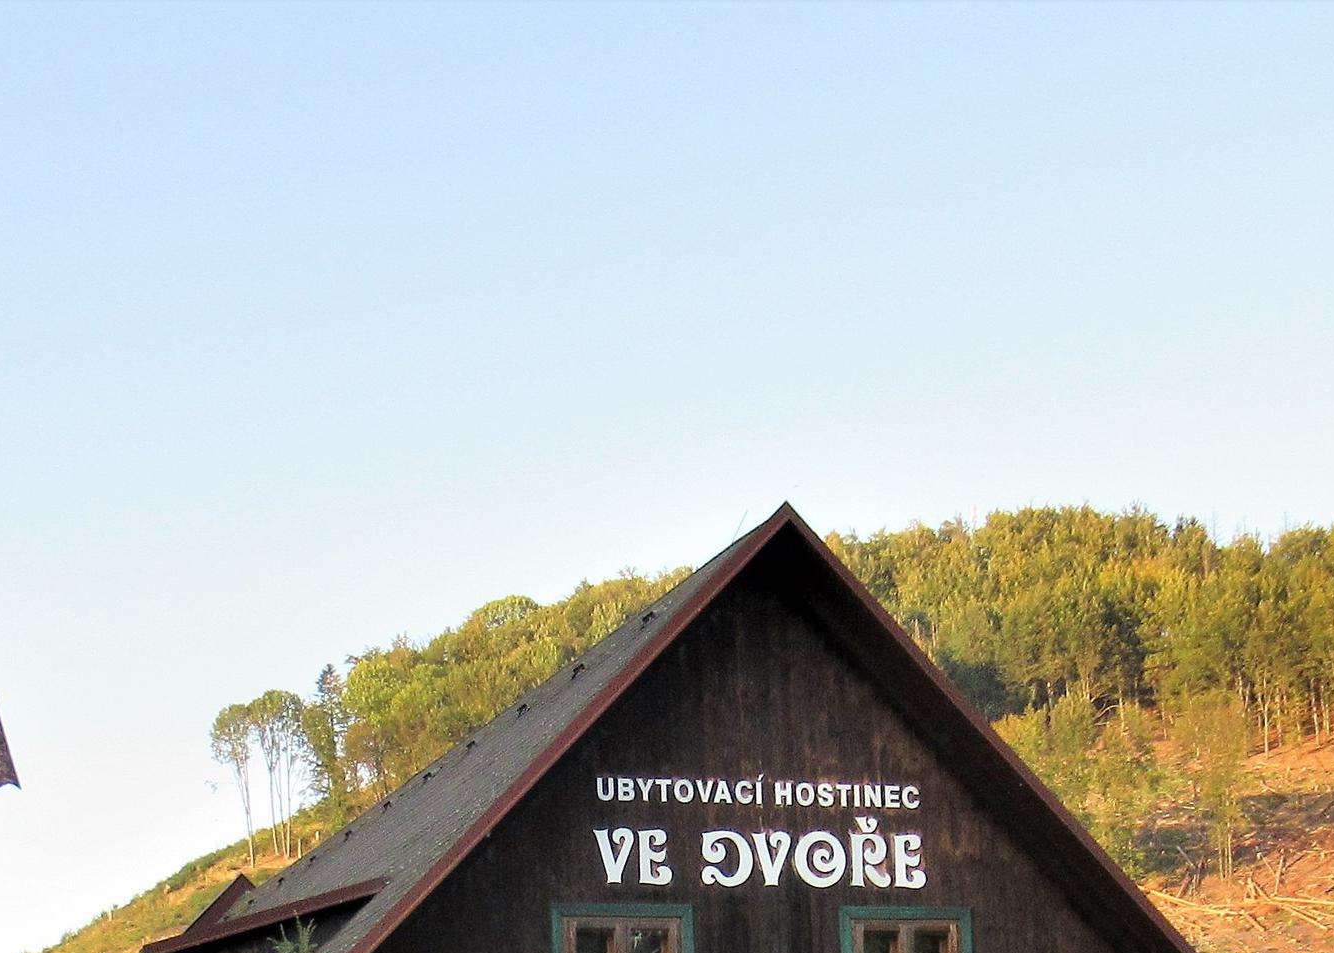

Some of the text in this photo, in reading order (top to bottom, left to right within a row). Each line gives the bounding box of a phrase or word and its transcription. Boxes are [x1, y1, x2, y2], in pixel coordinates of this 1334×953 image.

[596, 774, 921, 810] UBYTOVACÍ HOSTINEC
[593, 816, 927, 889] VE DVOŘE
